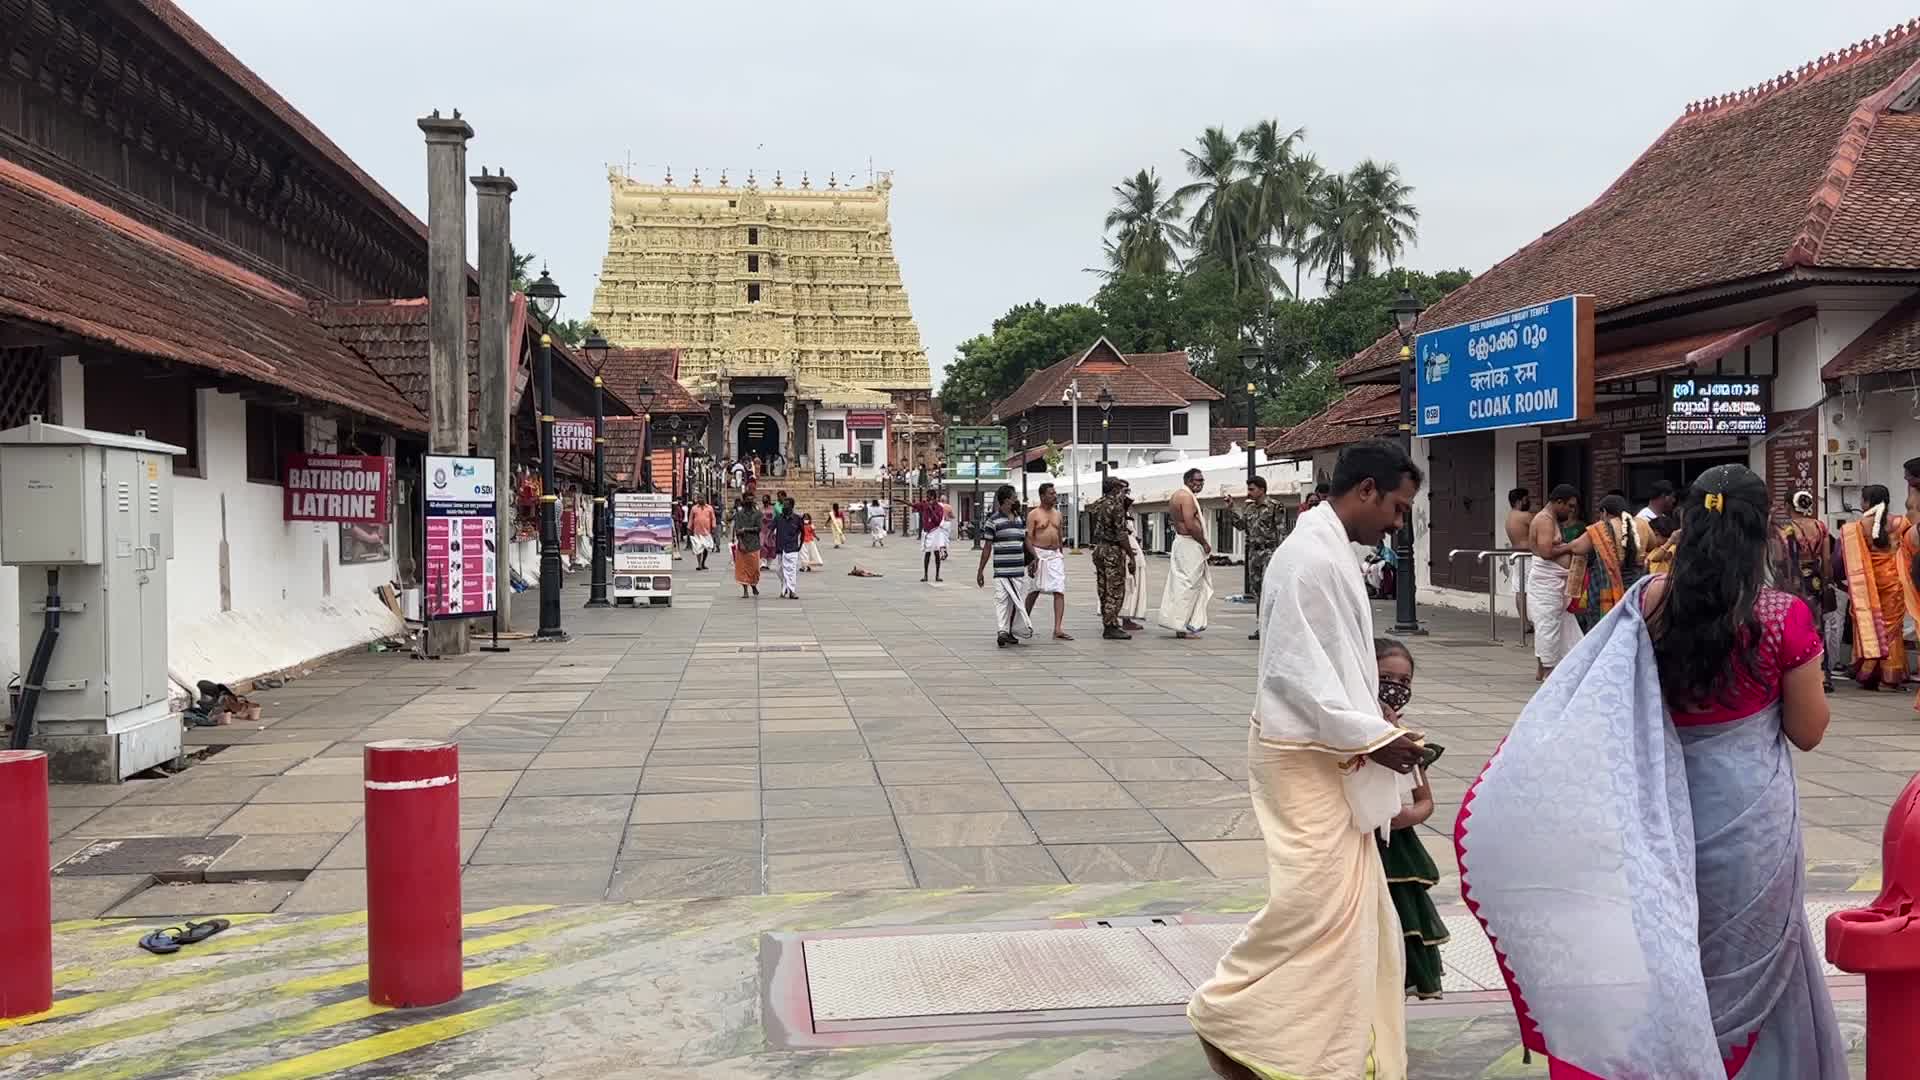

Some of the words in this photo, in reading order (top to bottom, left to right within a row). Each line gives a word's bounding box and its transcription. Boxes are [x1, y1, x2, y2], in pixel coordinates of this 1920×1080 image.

[1530, 305, 1549, 317] TEMPLE
[1469, 361, 1510, 391] क्लोक
[1673, 380, 1694, 398] ശ്രീ
[1469, 394, 1511, 420] CLOAK
[1515, 388, 1558, 414] ROOM
[1673, 397, 1710, 415] സ്വാമി
[289, 469, 380, 491] BATHROOM
[292, 493, 376, 518] LATRINE
